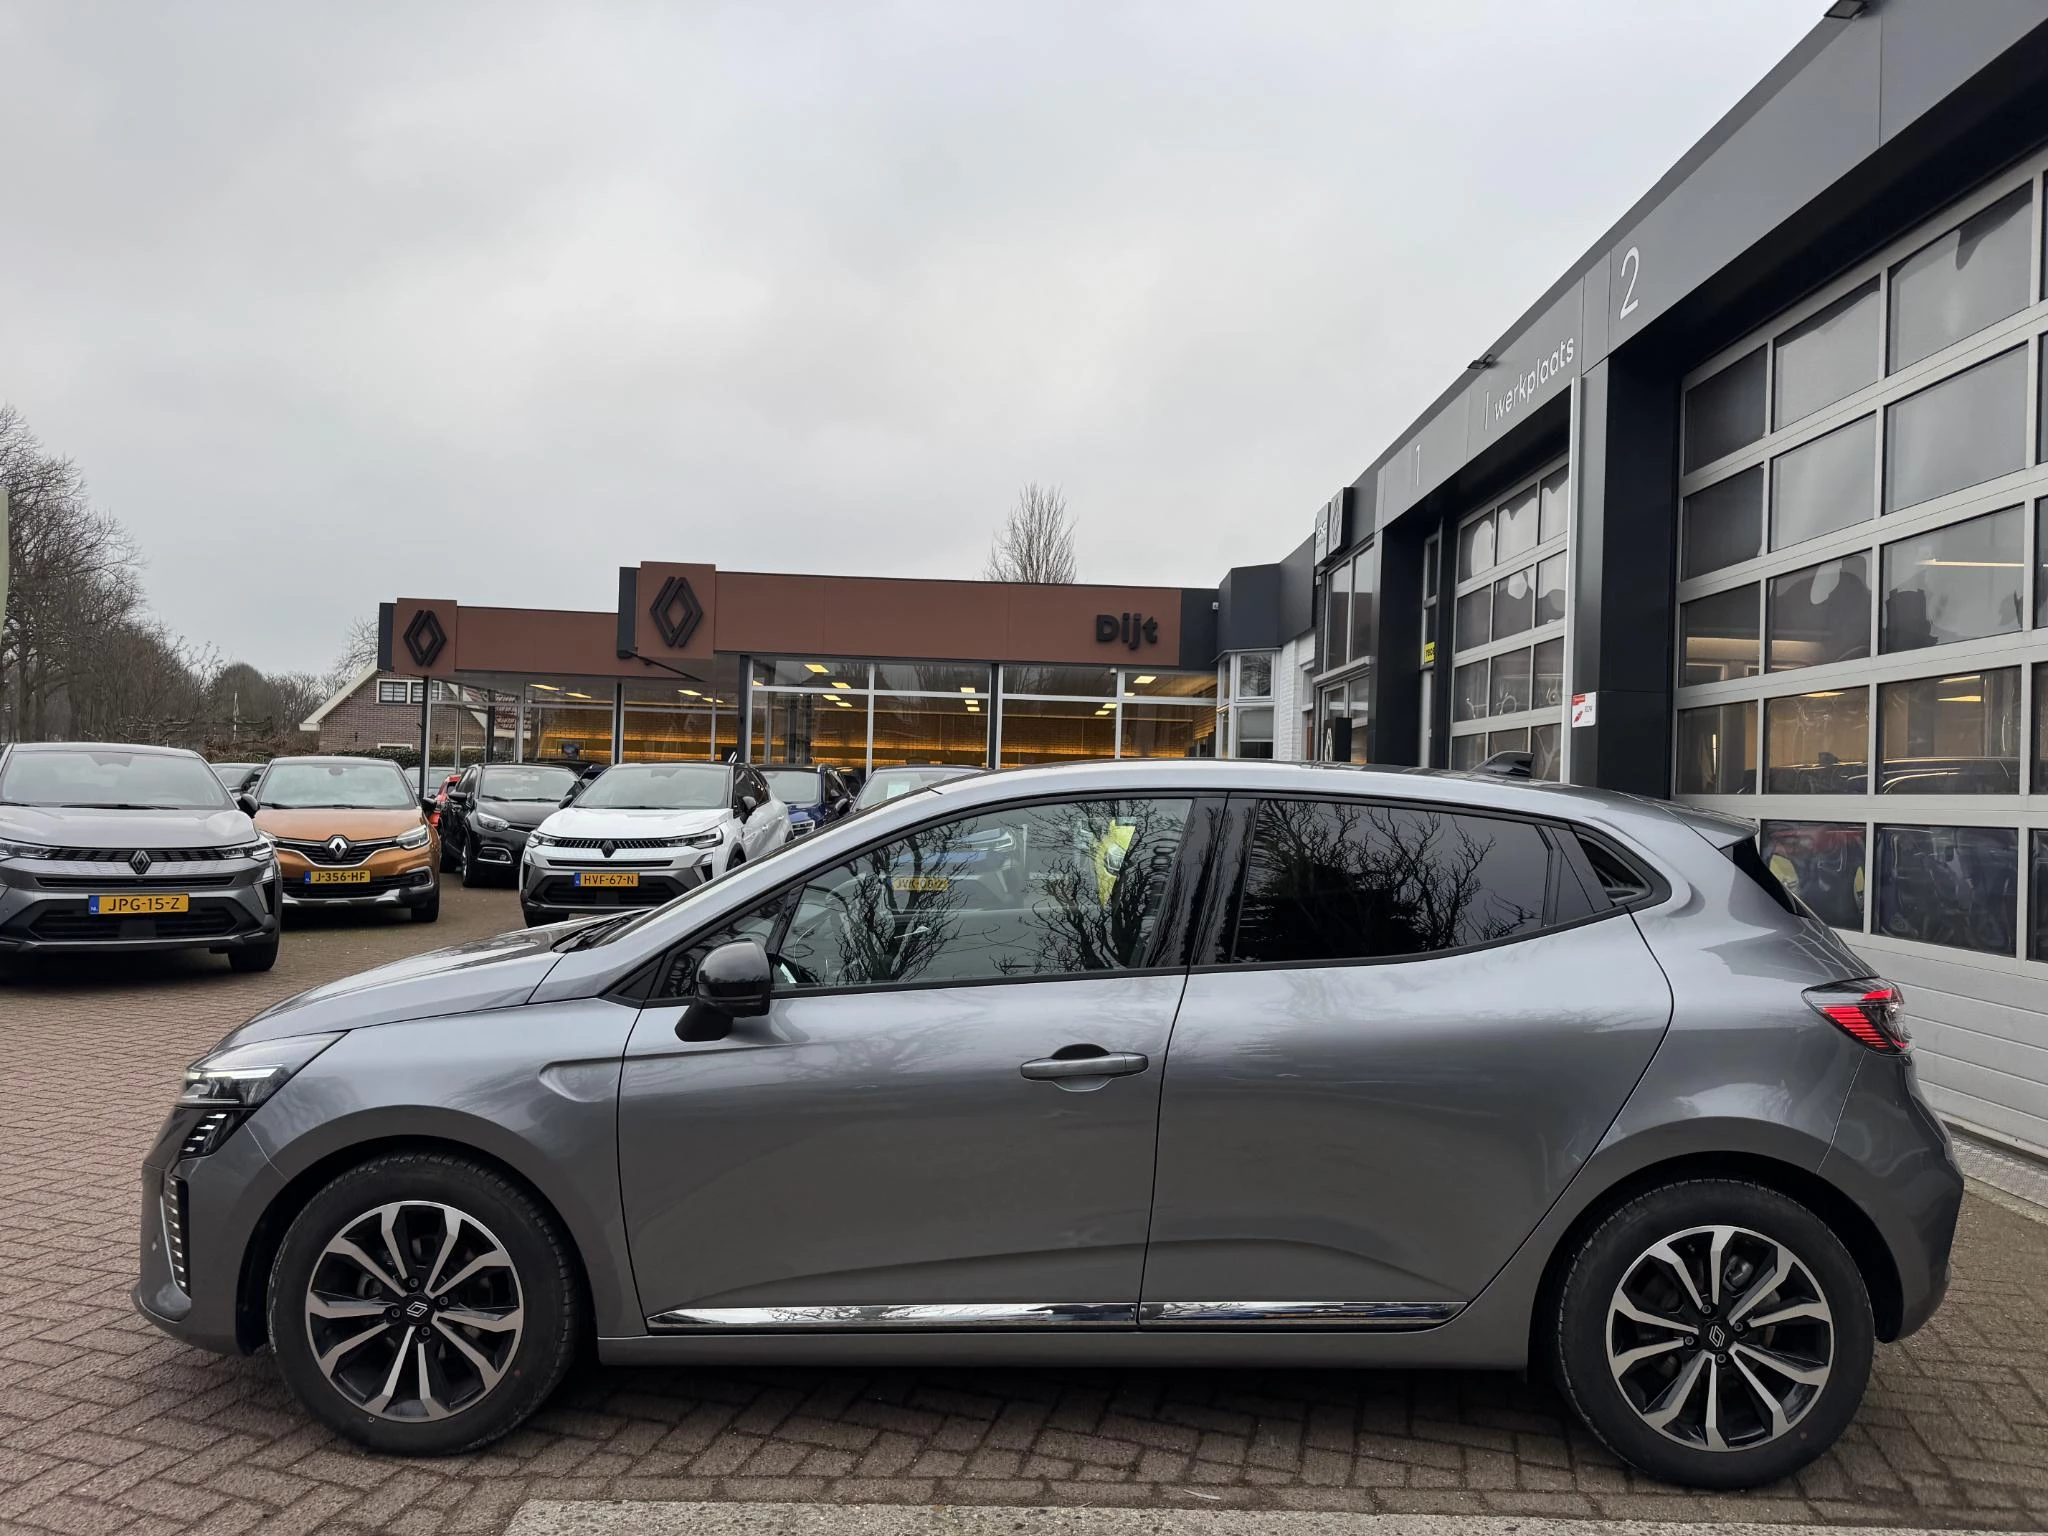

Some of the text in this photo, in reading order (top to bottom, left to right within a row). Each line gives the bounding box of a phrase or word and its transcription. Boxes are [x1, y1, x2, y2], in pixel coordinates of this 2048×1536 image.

[1619, 246, 1640, 320] 2
[1494, 337, 1574, 421] werkplaats
[1415, 443, 1421, 487] 1
[1096, 612, 1158, 650] Dijt
[315, 871, 366, 882] J-356-HF
[583, 874, 635, 885] HVF-67-N
[108, 897, 180, 911] JPG-15-Z
